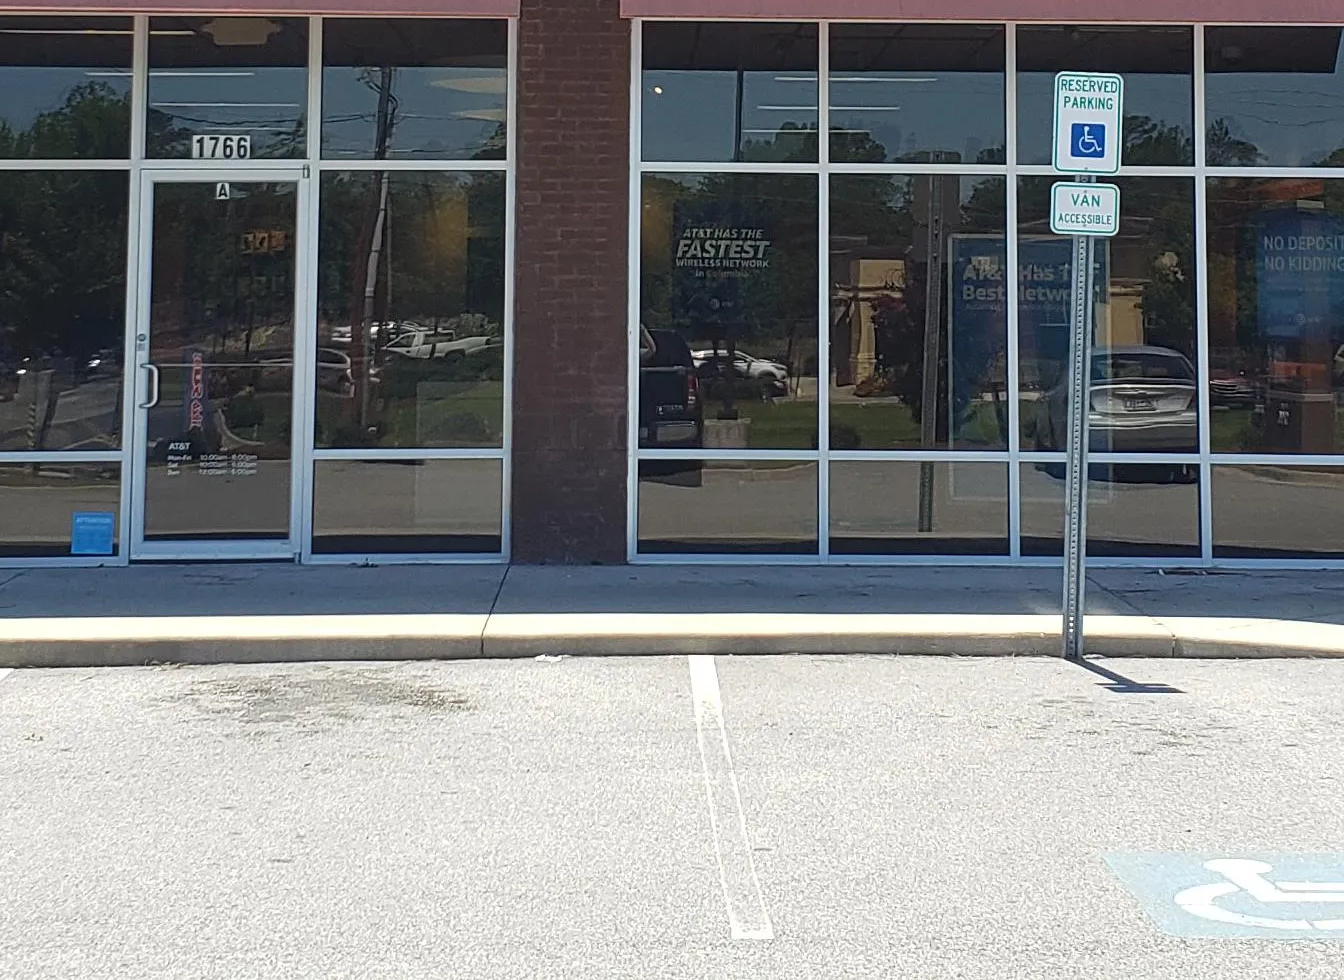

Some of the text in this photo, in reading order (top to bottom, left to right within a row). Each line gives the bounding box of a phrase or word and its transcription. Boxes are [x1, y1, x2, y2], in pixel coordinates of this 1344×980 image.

[1060, 78, 1118, 94] RESERVED
[1063, 95, 1114, 110] PARKING
[195, 136, 249, 159] 1766
[217, 183, 229, 198] A
[1071, 193, 1101, 207] VAN
[1057, 212, 1112, 226] ACCESSIBLE
[683, 228, 764, 239] AT&T HAS THE
[676, 239, 771, 259] FASTEST
[1264, 235, 1285, 251] NO
[675, 258, 769, 268] WIRELESS NETWORK
[1264, 255, 1285, 271] NO
[962, 284, 1006, 301] Best
